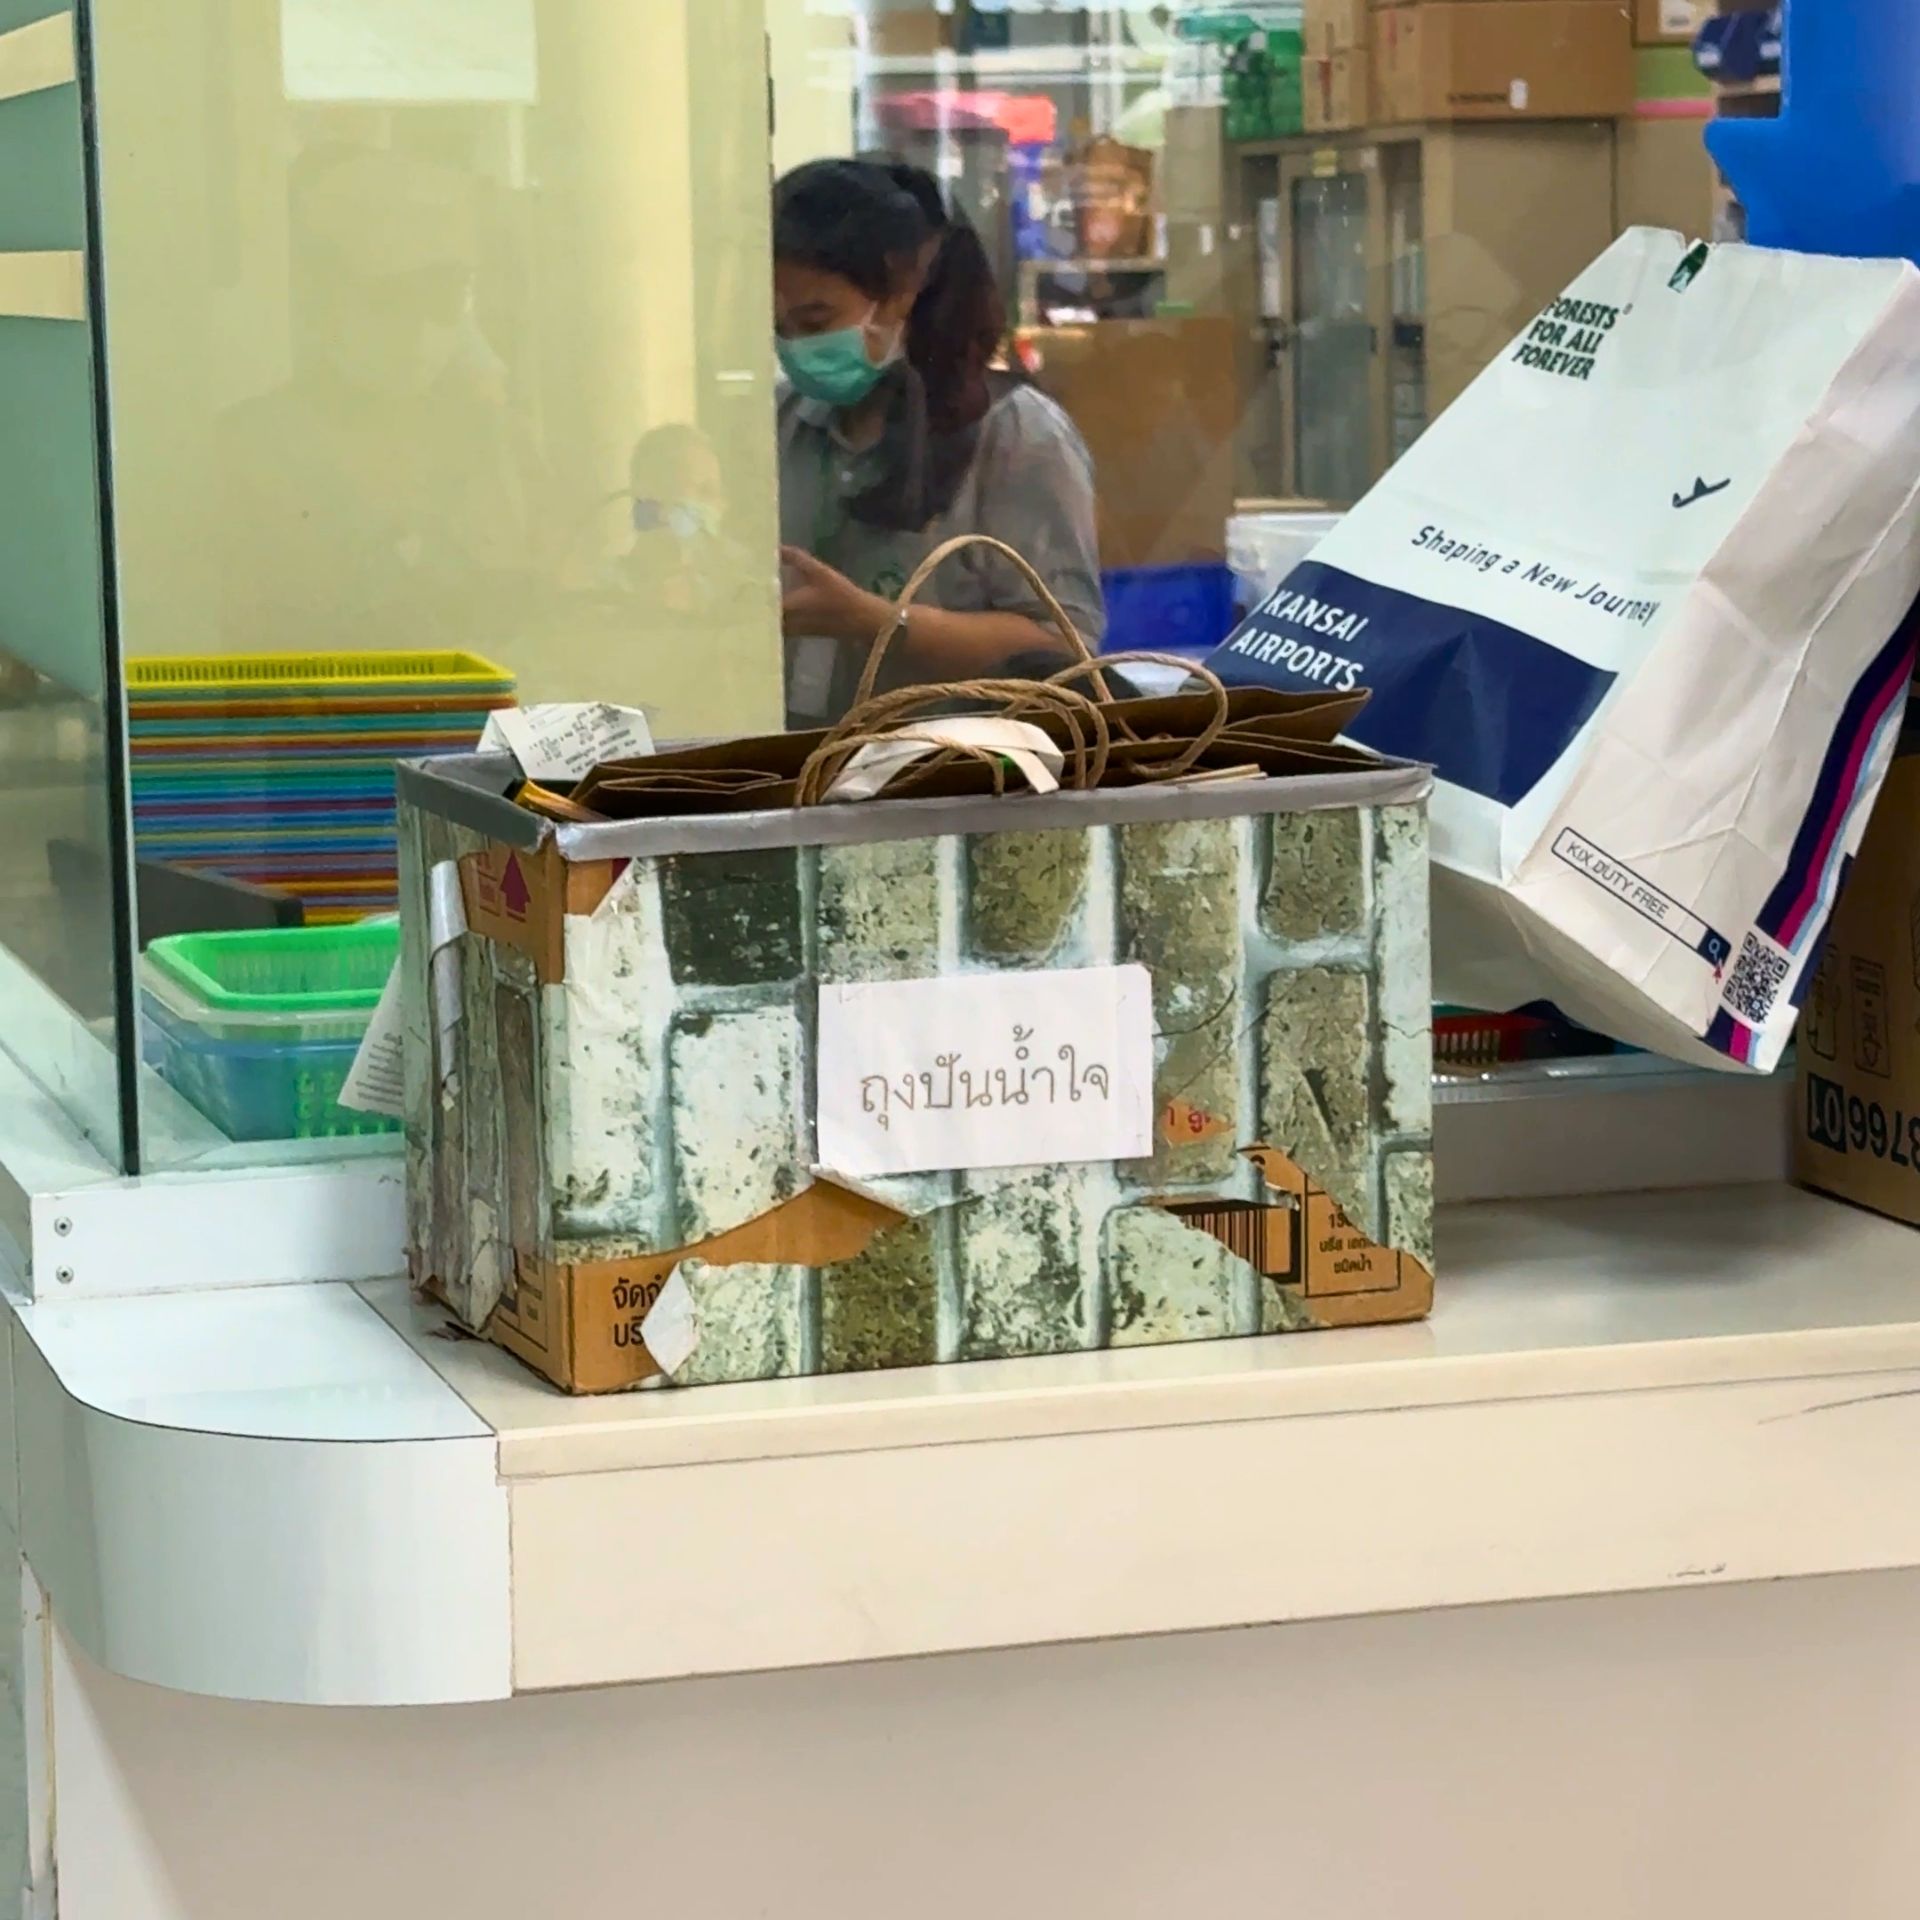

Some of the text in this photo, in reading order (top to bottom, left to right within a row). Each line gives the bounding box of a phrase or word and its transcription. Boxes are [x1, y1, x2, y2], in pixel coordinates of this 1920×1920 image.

[1527, 319, 1604, 354] FOR ALL
[1543, 296, 1619, 330] FORESTS
[1511, 343, 1595, 380] FOREVER
[1411, 525, 1662, 627] Shaping a New Journey
[1263, 589, 1369, 642] KANSAI
[1229, 627, 1364, 692] AIRPORTS
[1566, 841, 1669, 920] KIX DUTY FREE
[861, 1024, 1110, 1131] ถุงปันน้ำใจ
